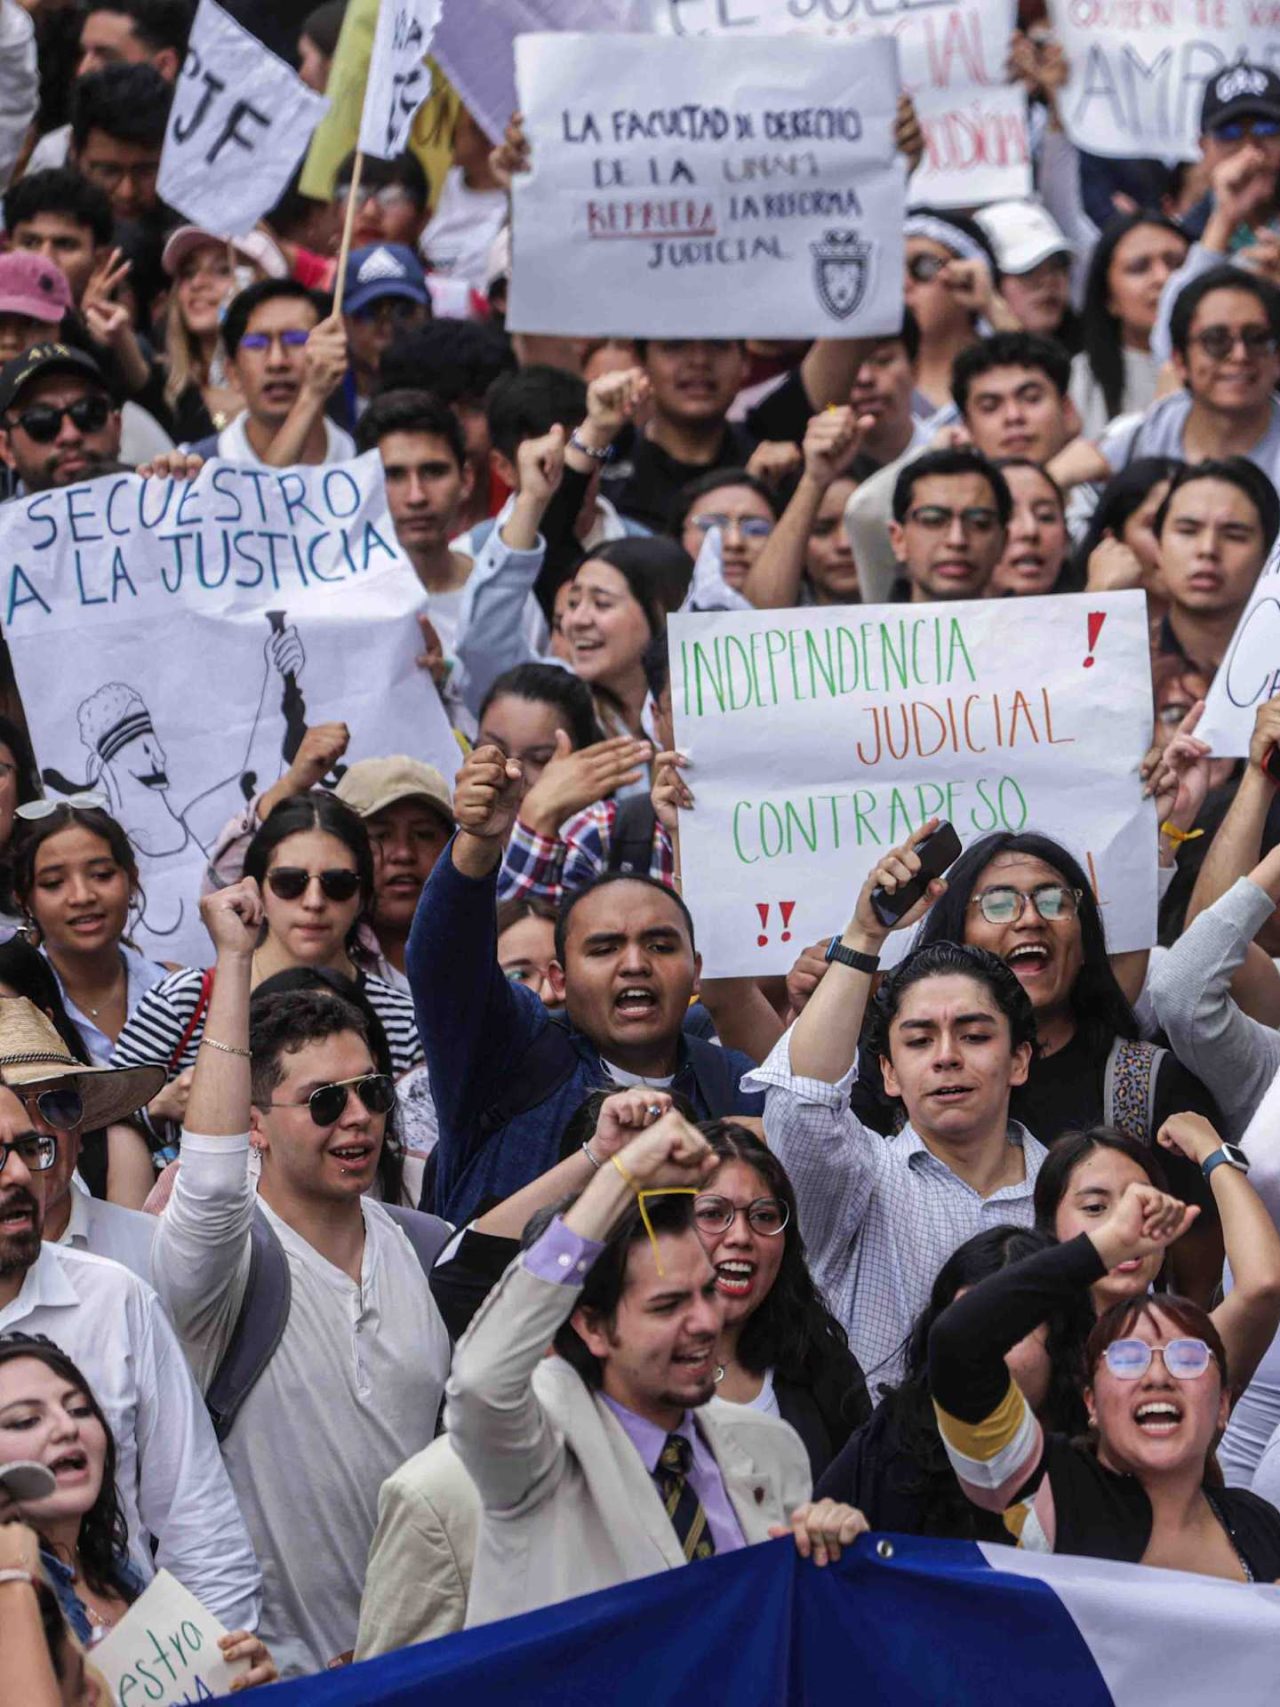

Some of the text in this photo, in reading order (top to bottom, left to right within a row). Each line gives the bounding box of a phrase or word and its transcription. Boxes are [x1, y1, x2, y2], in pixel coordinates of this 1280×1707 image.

[562, 108, 602, 143] LA
[612, 104, 729, 142] FACULTAD
[763, 108, 862, 143] DERECHO
[594, 157, 624, 189] DE
[649, 157, 696, 187] LA
[729, 193, 760, 221] LA
[764, 187, 863, 218] REFORMA
[648, 235, 793, 270] JUDICIAL
[26, 466, 362, 551] SECUESTRO
[5, 520, 397, 626] A LA JUSTICIA
[679, 616, 977, 717] INDEPENDENCIA
[857, 686, 1075, 766] JUDICIAL
[733, 775, 1028, 865] CONTRAPESO
